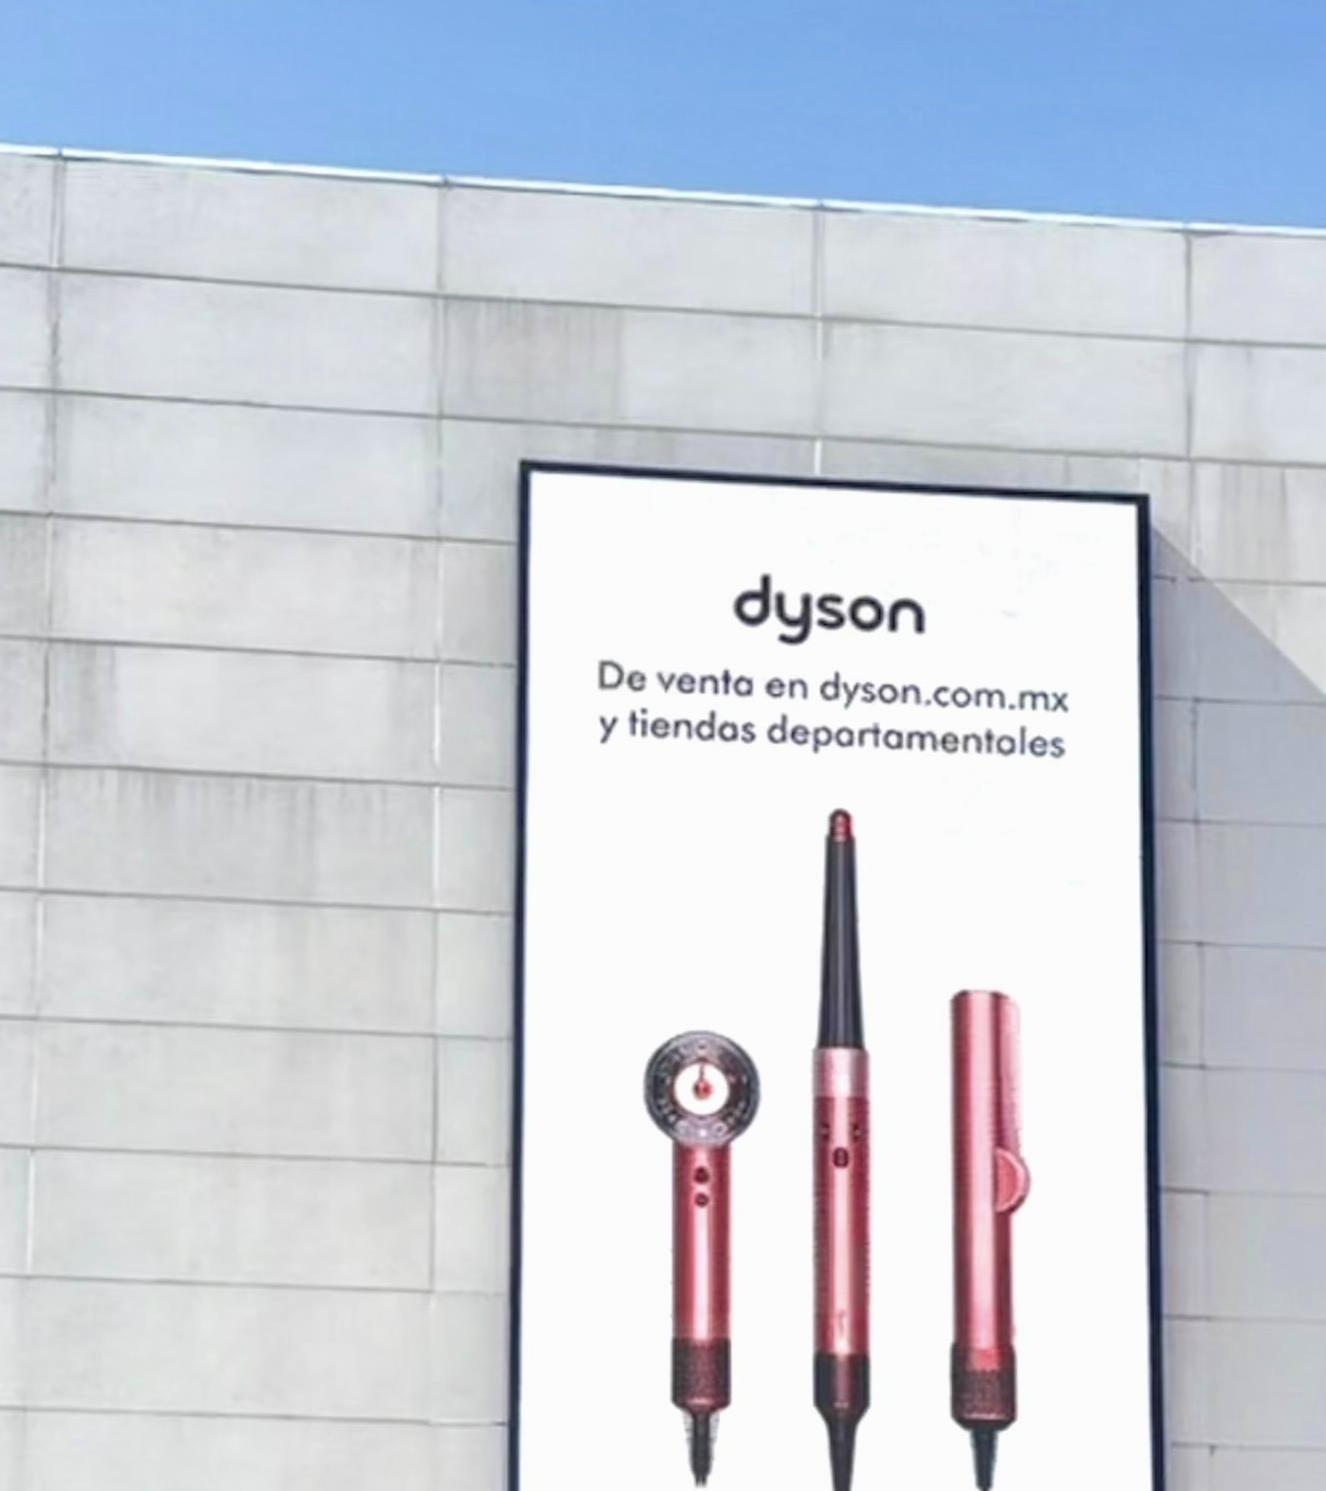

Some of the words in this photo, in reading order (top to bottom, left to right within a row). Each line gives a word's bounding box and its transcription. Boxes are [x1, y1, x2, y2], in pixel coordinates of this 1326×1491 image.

[732, 573, 926, 646] dyson
[598, 659, 647, 693] De
[656, 669, 754, 698] venta
[764, 677, 809, 700] en
[819, 671, 1069, 713] dyson.com.mx
[599, 716, 619, 744] y
[628, 707, 757, 744] tiendas
[766, 713, 1066, 759] departamentales
